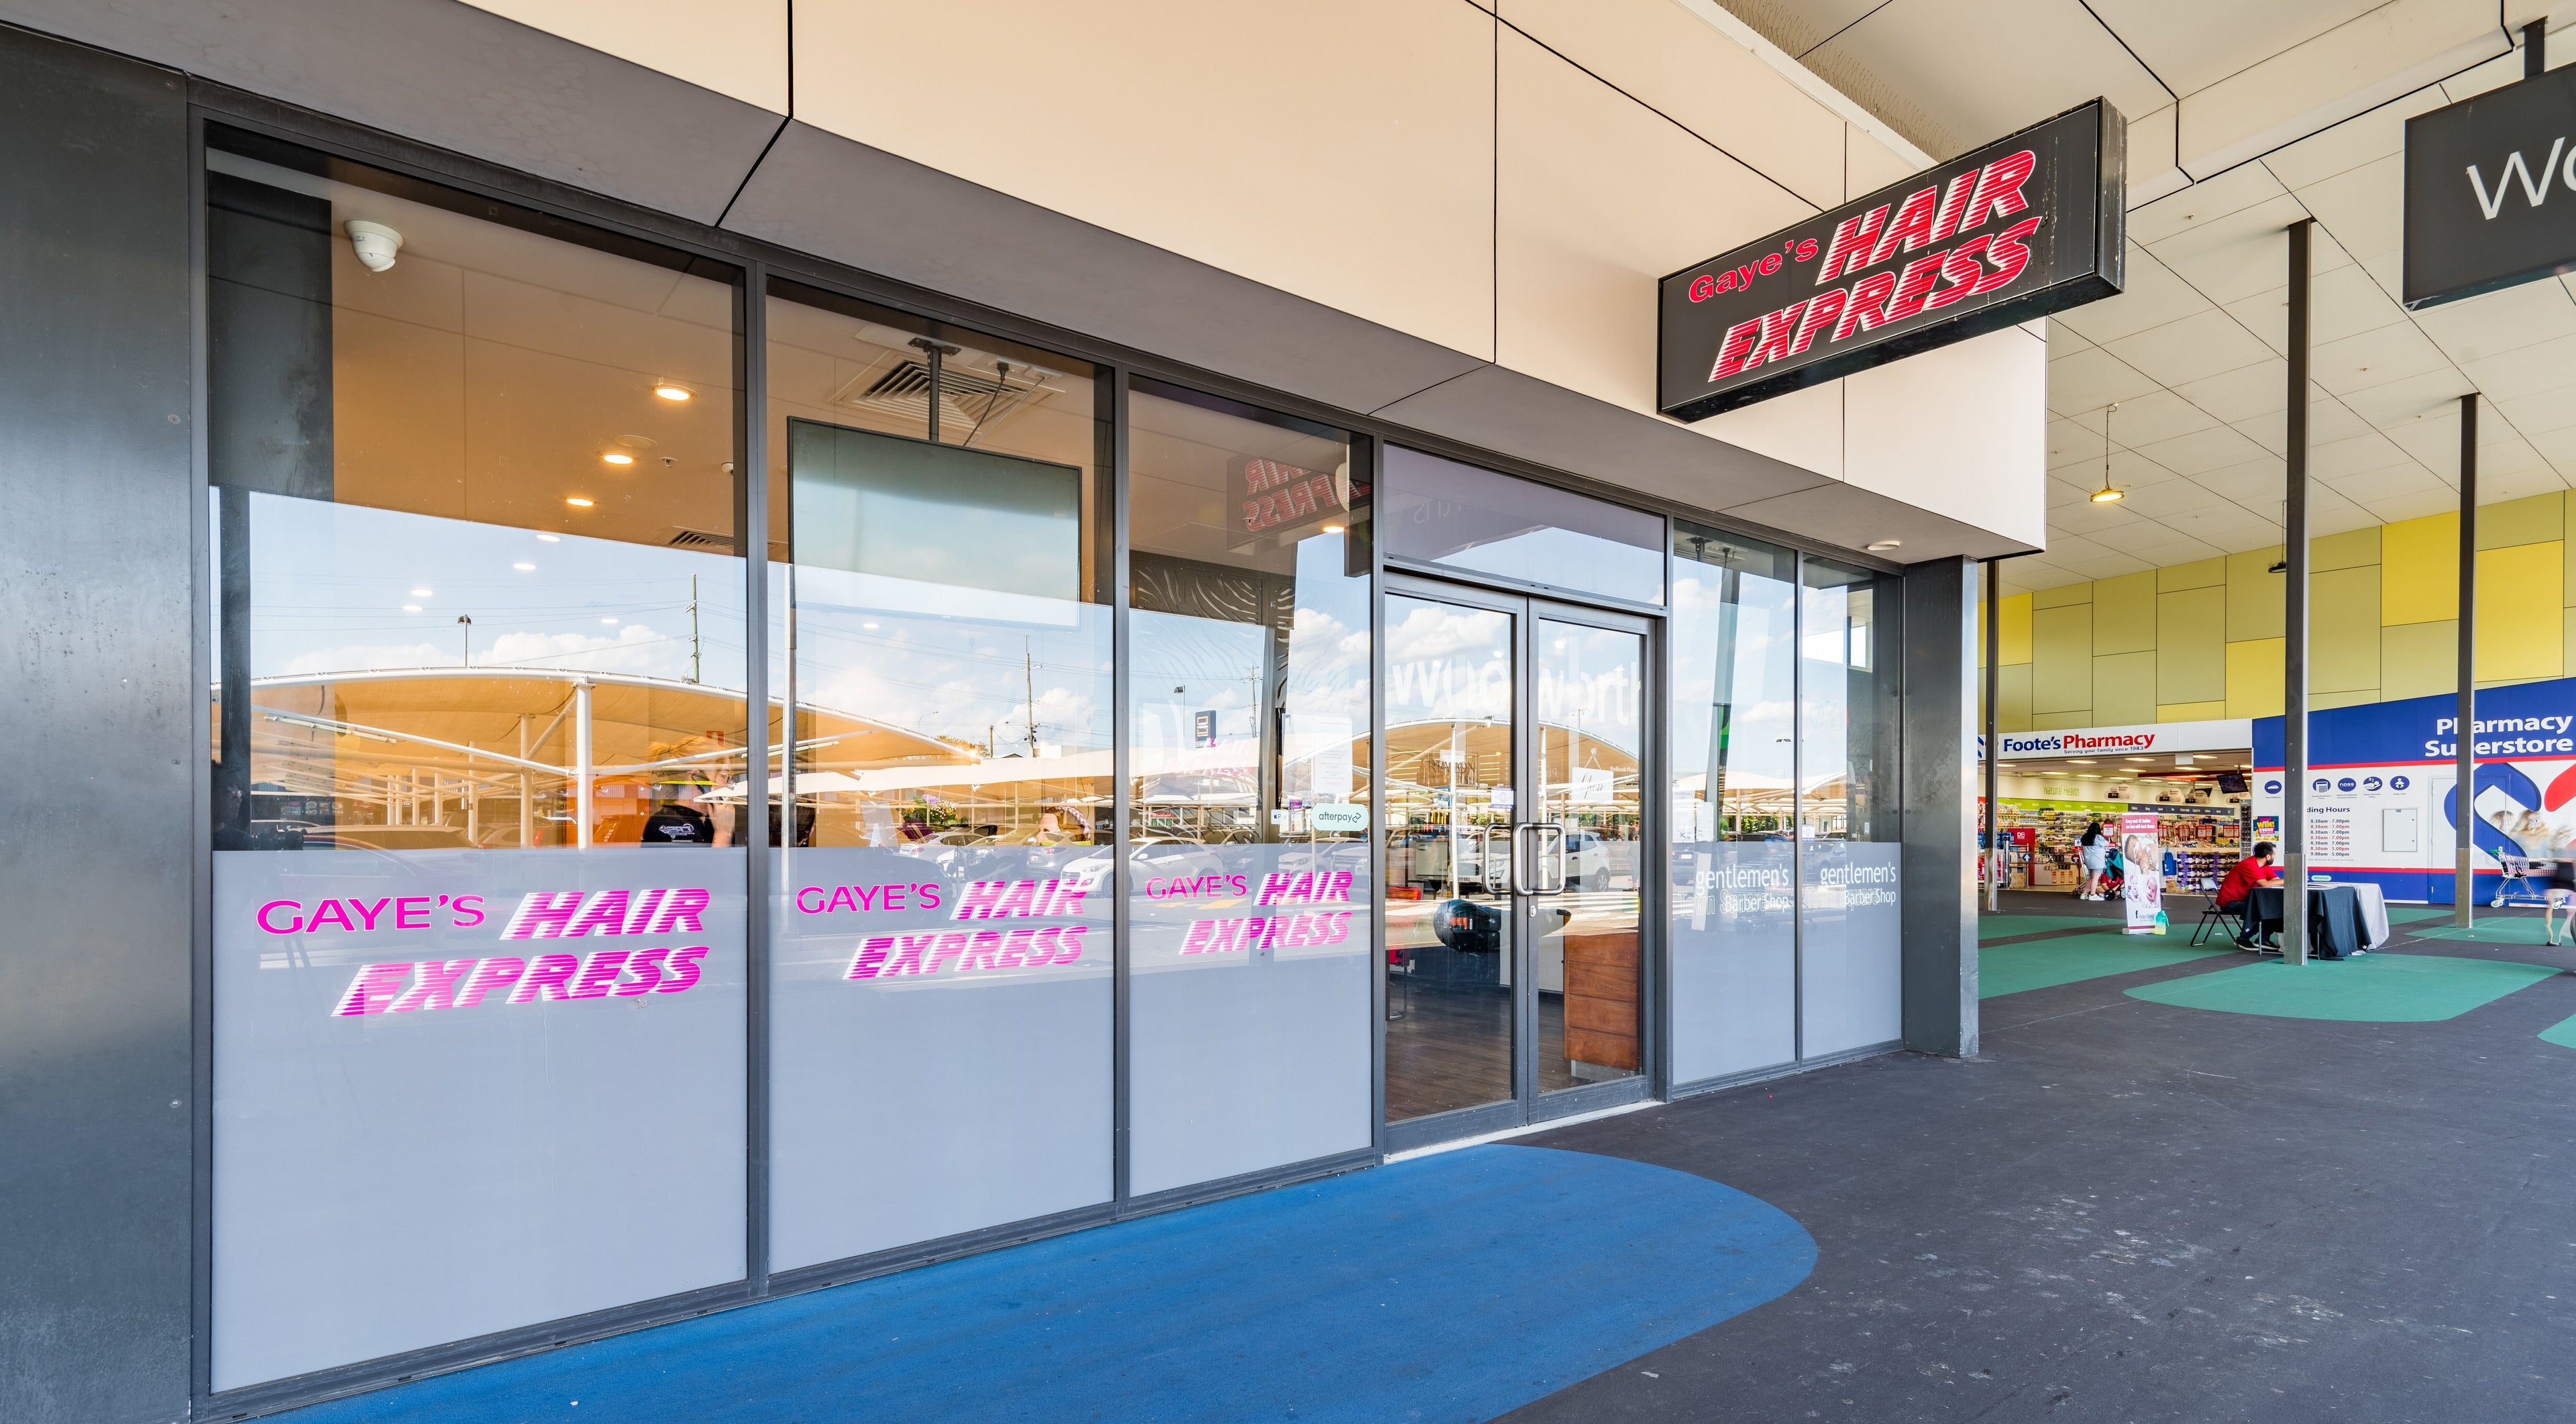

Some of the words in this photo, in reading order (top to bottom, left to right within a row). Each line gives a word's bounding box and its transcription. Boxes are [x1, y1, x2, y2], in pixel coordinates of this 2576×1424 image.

[1688, 237, 1819, 303] Gaye's
[1815, 150, 2036, 286] HAIR
[1708, 216, 2042, 382] EXPRESS
[2004, 736, 2061, 752] Foote's
[2063, 734, 2155, 749] Pharmacy
[2425, 737, 2573, 757] Suerstore
[2043, 785, 2062, 796] Natural
[2063, 786, 2080, 796] Health
[1319, 812, 1352, 823] afterpay
[1146, 875, 1248, 901] GAYE'S
[1252, 871, 1354, 907] HAIR
[1695, 863, 1789, 895] gentlemen's
[1820, 861, 1896, 885] gentlemen's
[256, 893, 486, 935] GAYE'S
[499, 887, 711, 940] HAIR
[796, 883, 941, 915] GAYE'S
[949, 878, 1087, 920] HAIR
[1725, 894, 1764, 913] Barber
[1764, 893, 1788, 913] Shop
[1845, 890, 1874, 906] Barber
[1874, 888, 1896, 907] Shop
[1179, 911, 1353, 956] EXPRESS
[843, 926, 1088, 980] EXPRESS
[330, 946, 710, 1018] EXPRESS
